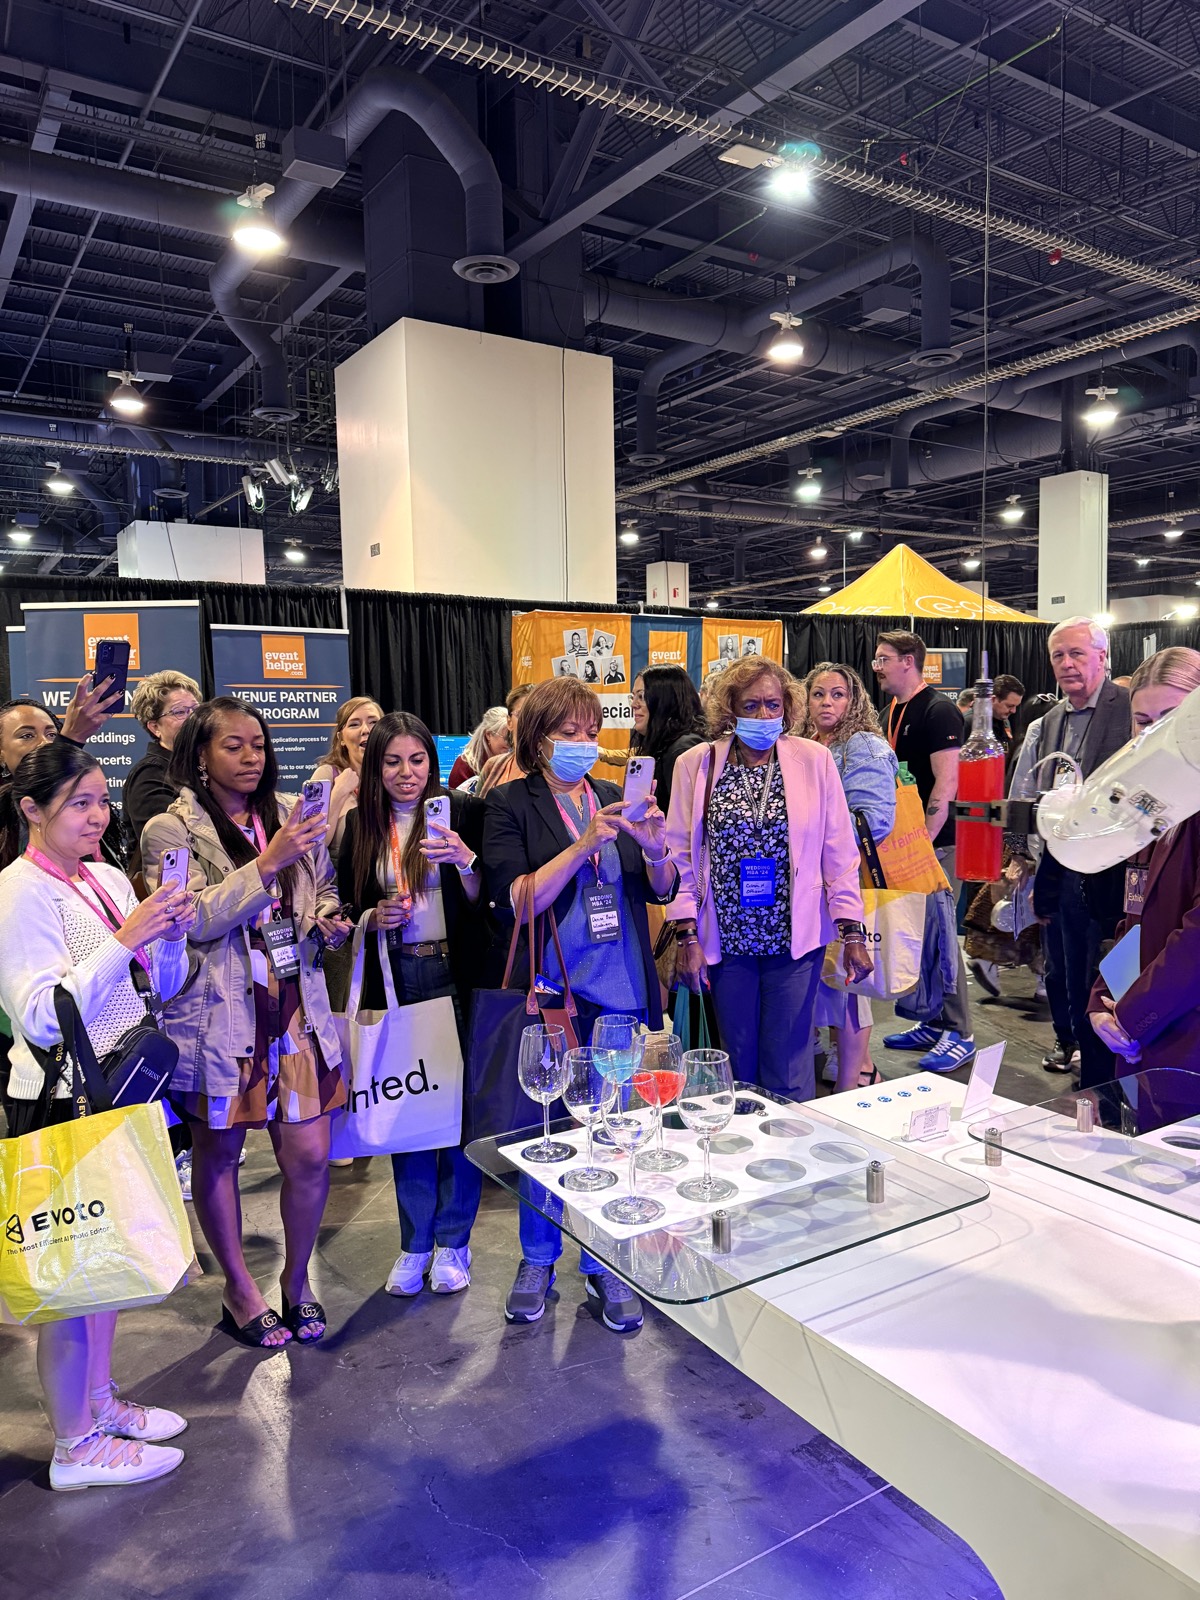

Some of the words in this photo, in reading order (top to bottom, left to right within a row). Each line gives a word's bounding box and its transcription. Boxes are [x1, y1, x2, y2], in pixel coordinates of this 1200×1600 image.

[265, 652, 299, 660] event
[651, 650, 681, 660] event
[266, 660, 304, 672] helper
[42, 691, 71, 707] WE
[232, 691, 277, 703] VENUE
[280, 691, 338, 703] PARTNER
[86, 732, 136, 745] eddings
[96, 755, 132, 765] ncerts
[588, 893, 613, 902] WEDDING
[267, 926, 294, 938] WEDDING
[140, 1065, 160, 1081] GUESS
[6, 1248, 19, 1256] The
[19, 1242, 39, 1253] Most
[70, 1231, 89, 1241] Photo
